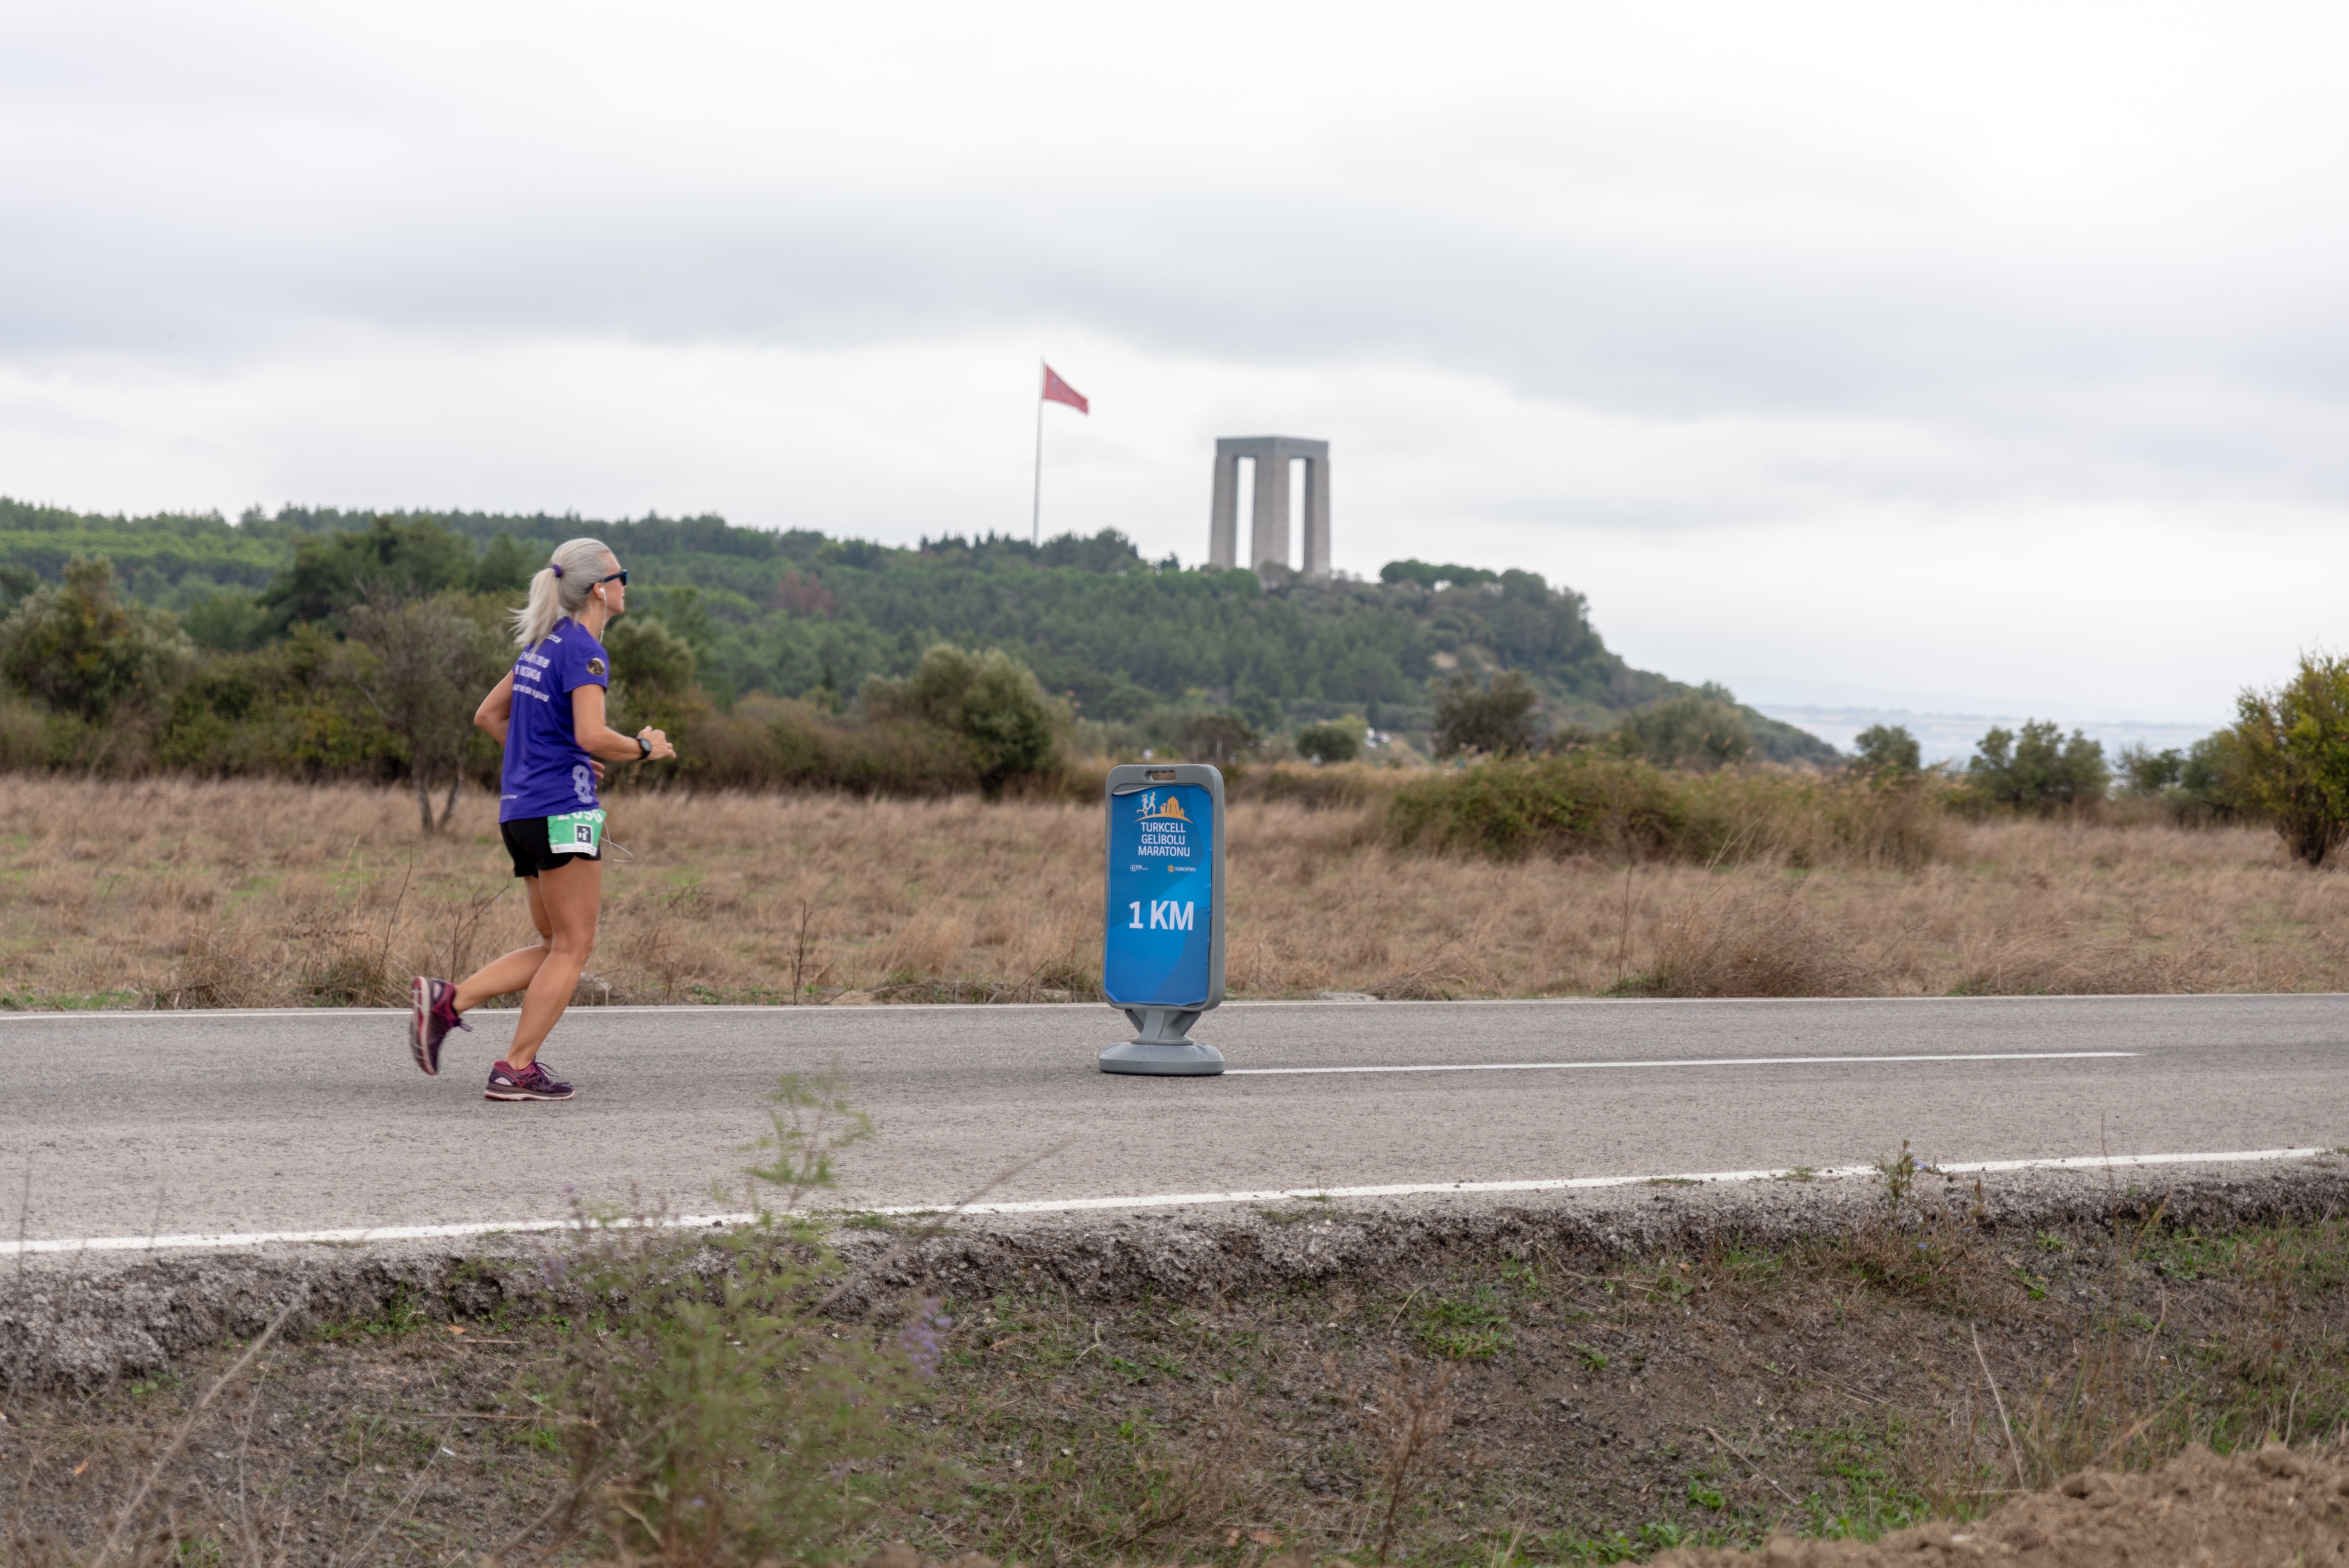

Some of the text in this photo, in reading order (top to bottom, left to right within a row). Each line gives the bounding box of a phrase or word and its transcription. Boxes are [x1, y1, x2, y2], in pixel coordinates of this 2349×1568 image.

[1141, 822, 1186, 833] TURKCELL
[1141, 833, 1185, 845] GELİBOLU
[1138, 845, 1190, 857] MARATONU
[1129, 900, 1194, 930] 1 KM
